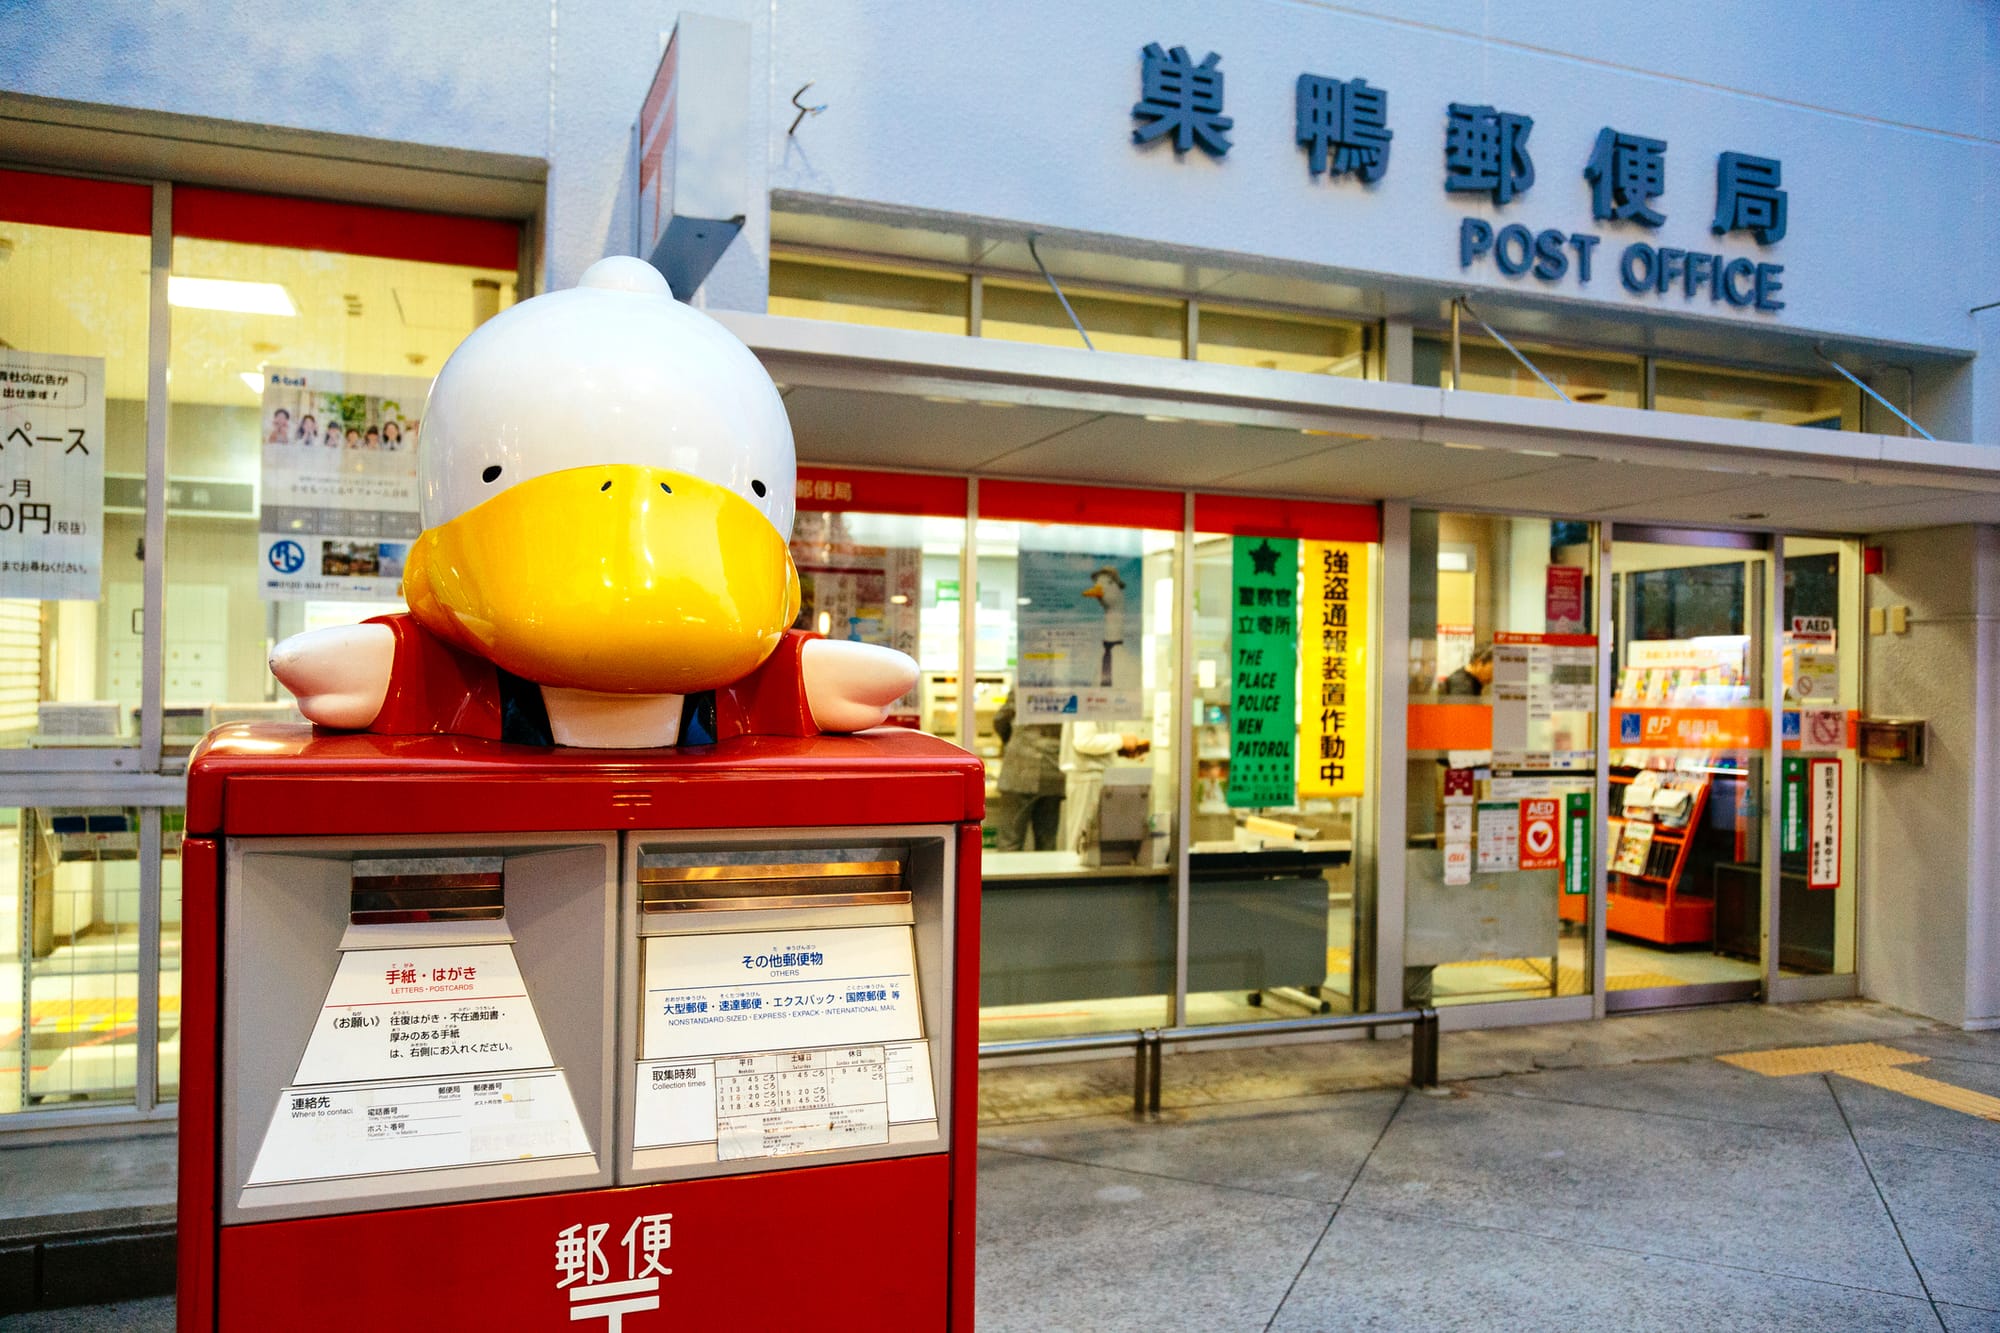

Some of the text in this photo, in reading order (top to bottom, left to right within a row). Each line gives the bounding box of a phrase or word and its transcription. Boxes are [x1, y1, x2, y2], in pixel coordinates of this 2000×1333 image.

[1131, 42, 1789, 246] 巣鴨郵便局
[1460, 216, 1786, 312] POST OFFICE
[0, 421, 89, 456] ペース
[1806, 619, 1830, 633] AED
[1239, 649, 1263, 666] THE
[1320, 549, 1349, 787] 強盗通報装置作動中
[1238, 672, 1277, 689] PLACE
[1237, 695, 1281, 712] POLICE
[1237, 718, 1263, 735] MEN
[1236, 740, 1290, 758] PATOROL
[1528, 802, 1555, 815] AED
[742, 951, 824, 969] その他郵便物
[385, 967, 477, 985] 手紙・はがき
[880, 1004, 896, 1012] MAIL
[390, 1029, 460, 1042] 厚みのある手紙
[652, 1067, 697, 1081] 取集時刻
[652, 1081, 686, 1090] Collection
[291, 1096, 331, 1111] 連絡先
[555, 1212, 673, 1289] 郵便
